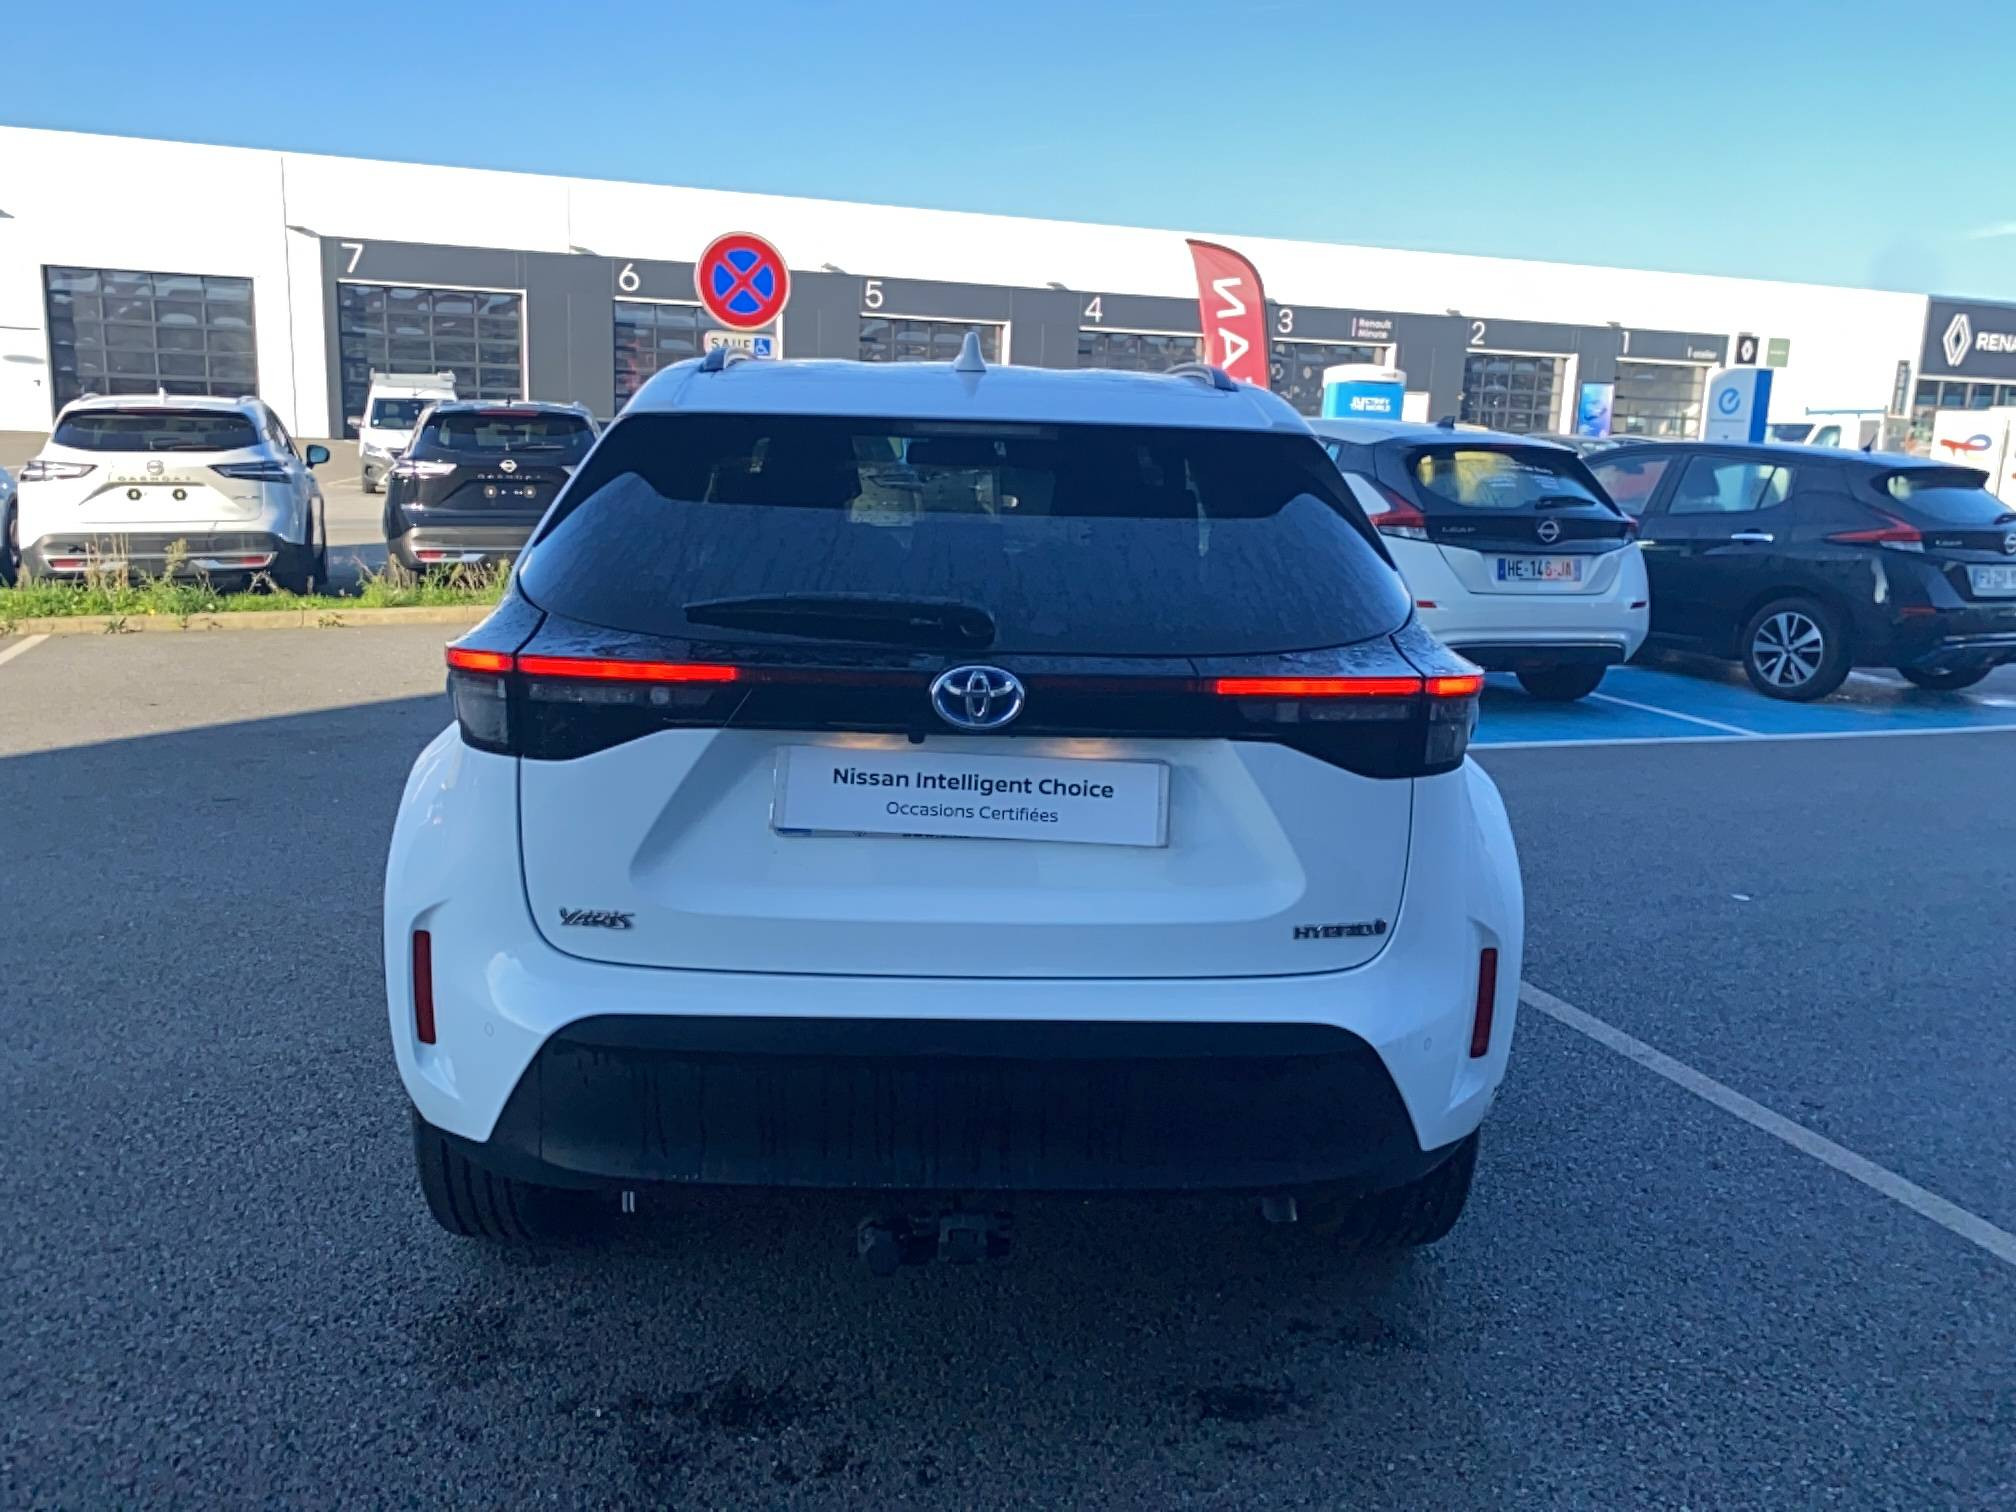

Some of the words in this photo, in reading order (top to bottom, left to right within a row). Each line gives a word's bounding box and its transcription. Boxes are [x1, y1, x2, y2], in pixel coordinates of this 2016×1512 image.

[341, 243, 364, 273] 7
[618, 262, 640, 292] 6
[865, 281, 884, 308] 5
[1085, 296, 1103, 323] 4
[1277, 308, 1293, 333] 3
[1471, 321, 1486, 345] 2
[1622, 331, 1630, 354] 1
[833, 767, 909, 788] Nissan
[916, 771, 1033, 797] Intelligent
[1038, 778, 1115, 799] Choice
[886, 801, 975, 819] Occasions
[978, 805, 1059, 823] Certifiées
